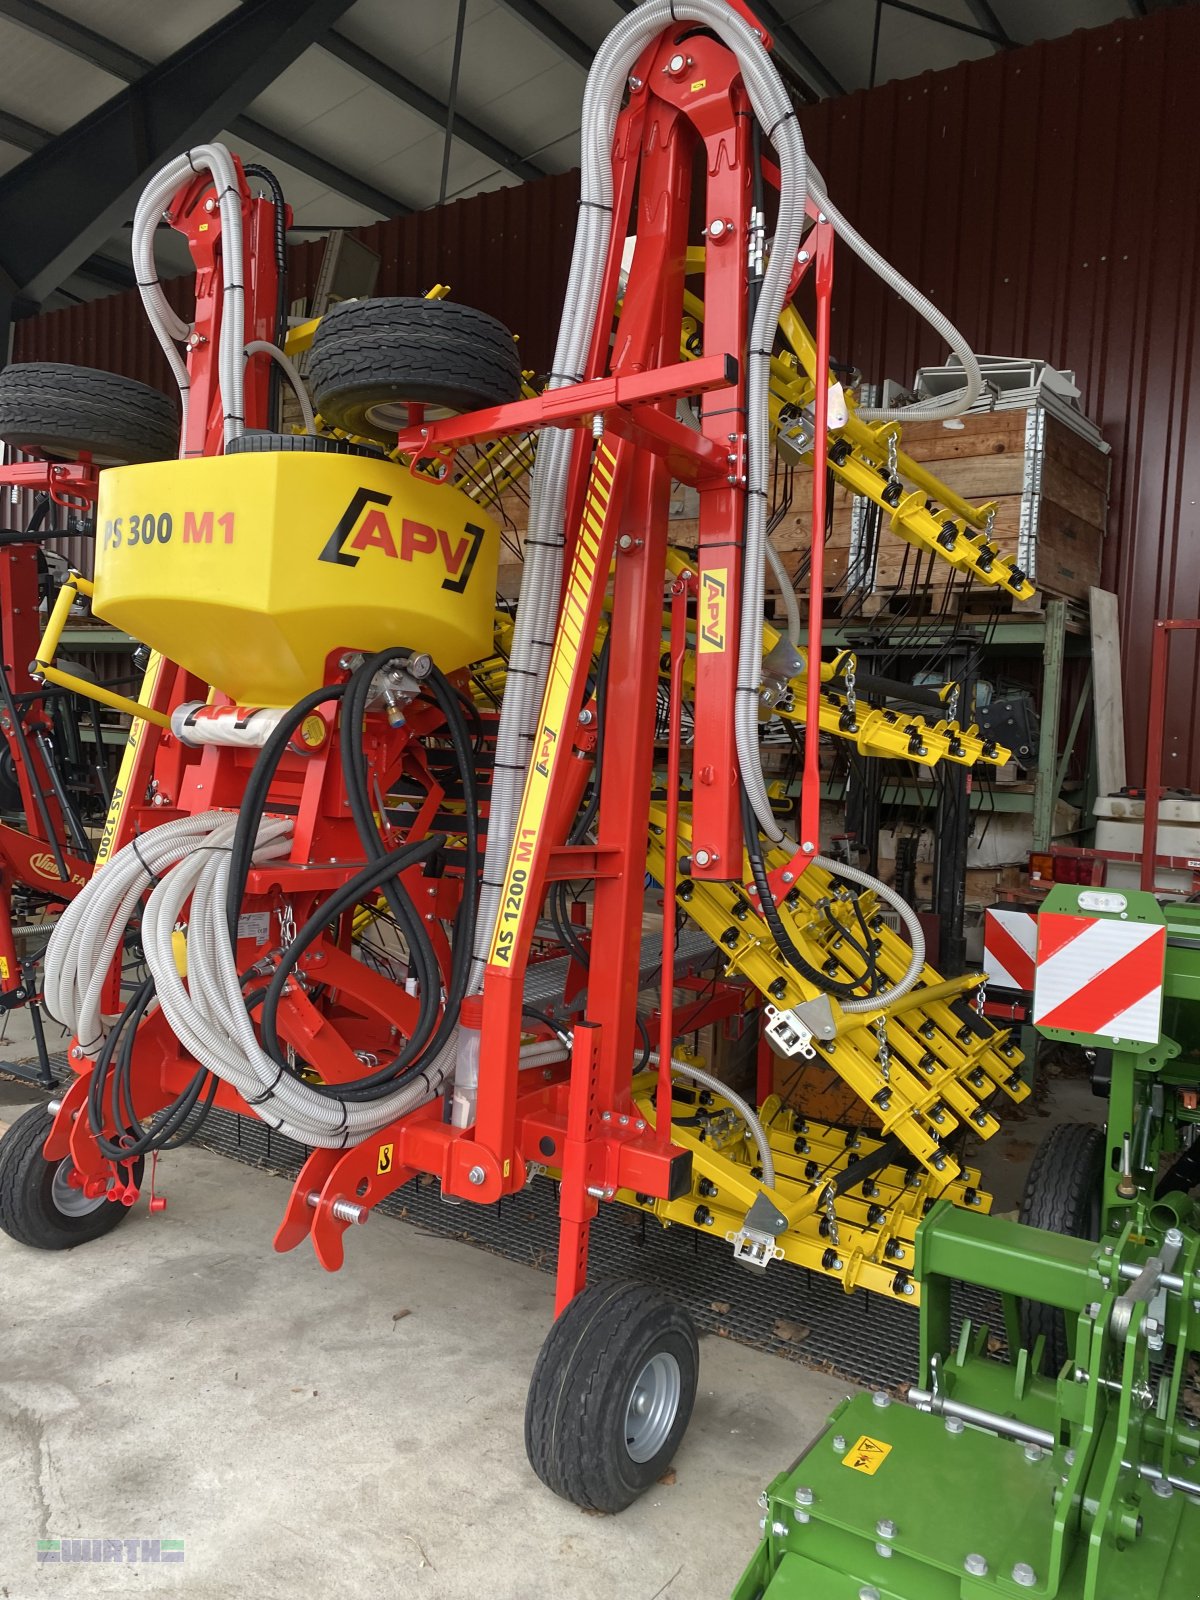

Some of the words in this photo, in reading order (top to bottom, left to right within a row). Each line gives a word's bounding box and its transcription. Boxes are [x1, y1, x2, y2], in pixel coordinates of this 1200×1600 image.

[103, 517, 123, 551] PS
[127, 512, 173, 546] 300
[182, 511, 235, 544] M1
[110, 787, 124, 811] AS
[98, 818, 116, 858] 1200
[515, 829, 537, 863] M1
[504, 869, 527, 922] 1200
[495, 930, 514, 962] AS
